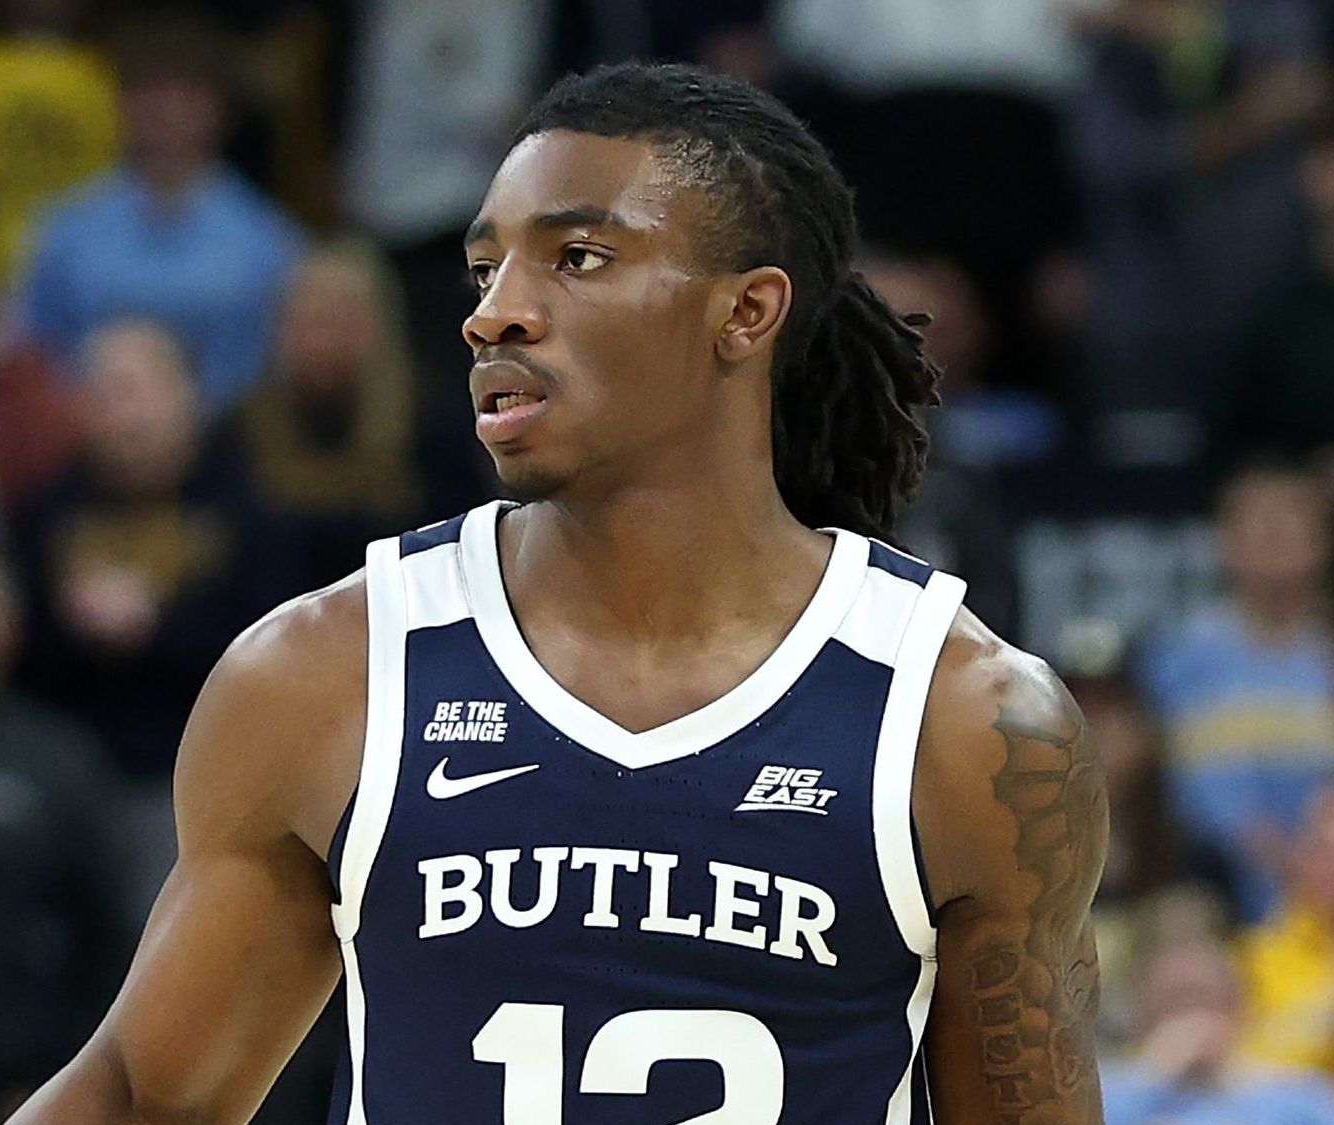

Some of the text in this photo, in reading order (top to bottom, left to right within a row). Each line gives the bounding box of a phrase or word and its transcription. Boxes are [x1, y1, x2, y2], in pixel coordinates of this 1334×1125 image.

[433, 701, 507, 722] BE THE
[423, 721, 508, 742] CHANGE
[755, 765, 823, 787] BIG
[743, 784, 838, 807] EAST
[417, 846, 839, 967] BUTLER
